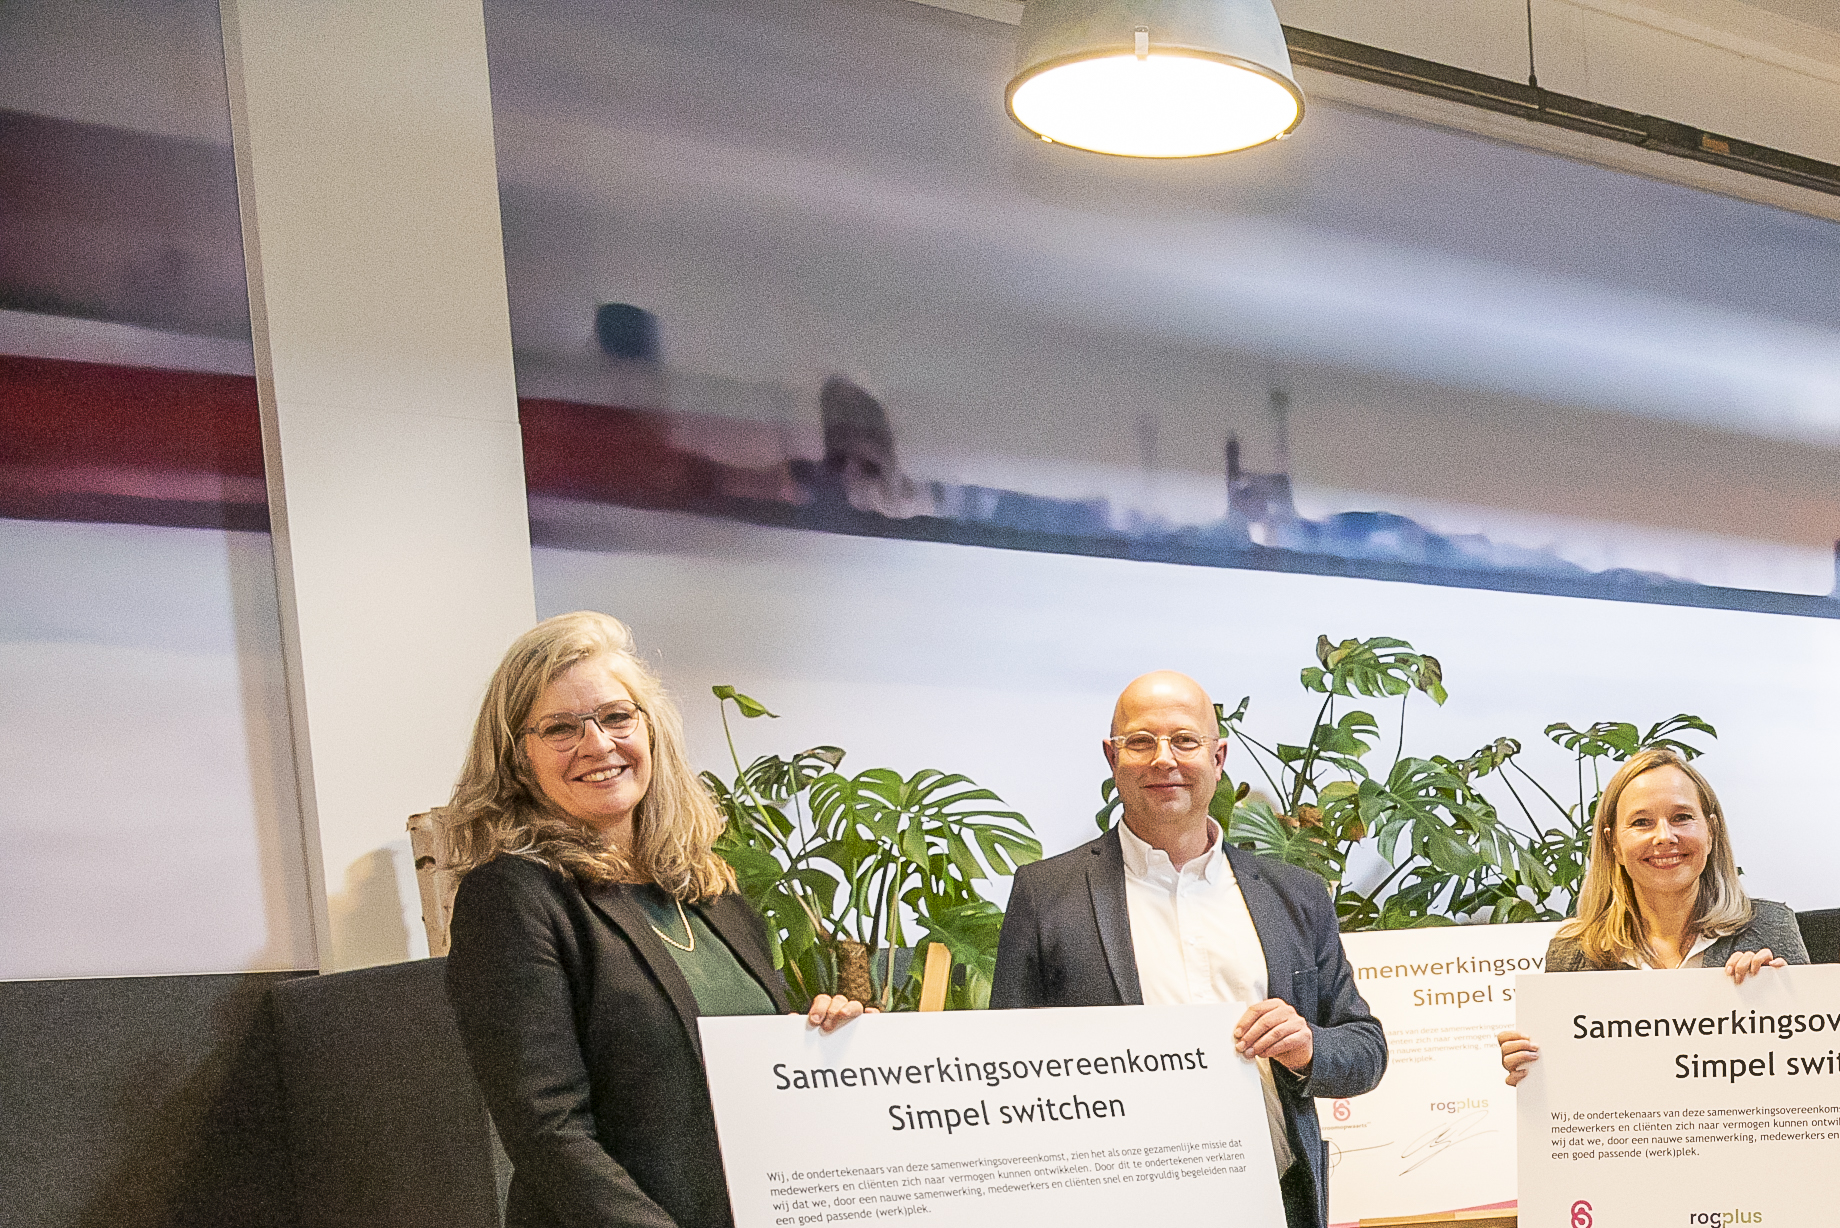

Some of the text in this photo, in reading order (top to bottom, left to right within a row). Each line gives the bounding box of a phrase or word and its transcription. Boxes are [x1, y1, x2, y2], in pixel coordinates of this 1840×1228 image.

[1358, 957, 1544, 980] menwerkingsov
[1414, 985, 1492, 1008] Simpel
[773, 1048, 1207, 1090] Samenwerkingsovereenkomst
[1676, 1051, 1775, 1083] Simpel
[889, 1096, 1125, 1134] Simpel switchen
[1431, 1099, 1488, 1113] rogplus
[1550, 1111, 1571, 1123] Wij,
[1572, 1111, 1585, 1120] de
[1586, 1109, 1662, 1120] ondertekenaars
[1663, 1110, 1680, 1118] van
[1682, 1108, 1705, 1118] deze
[1551, 1123, 1616, 1134] medewerkers
[1618, 1124, 1630, 1132] en
[1633, 1122, 1673, 1132] cliënten
[1675, 1121, 1695, 1131] zich
[1698, 1122, 1720, 1130] naar
[1722, 1121, 1770, 1131] vermogen
[1773, 1118, 1809, 1128] kunnen
[1551, 1139, 1566, 1149] wij
[1568, 1137, 1585, 1146] dat
[1586, 1138, 1605, 1147] we,
[1607, 1136, 1629, 1145] door
[1631, 1137, 1649, 1145] een
[1651, 1136, 1683, 1144] nauwe
[1685, 1132, 1757, 1144] samenwerking,
[1760, 1130, 1826, 1141] medewerkers
[1827, 1132, 1840, 1140] en
[766, 1139, 1243, 1184] Wij, de ondertekenaars van deze samenwerkingsovereenkomst, zien het als onze gezamenlijke missie dat
[1551, 1146, 1700, 1161] een goed passende (werk)plek.
[770, 1152, 1245, 1197] medewerkers en cliënten zich naar vermogen kunnen ontwikkelen. Door dit te ondertekenen verklaren
[1691, 1209, 1762, 1228] rogplus
